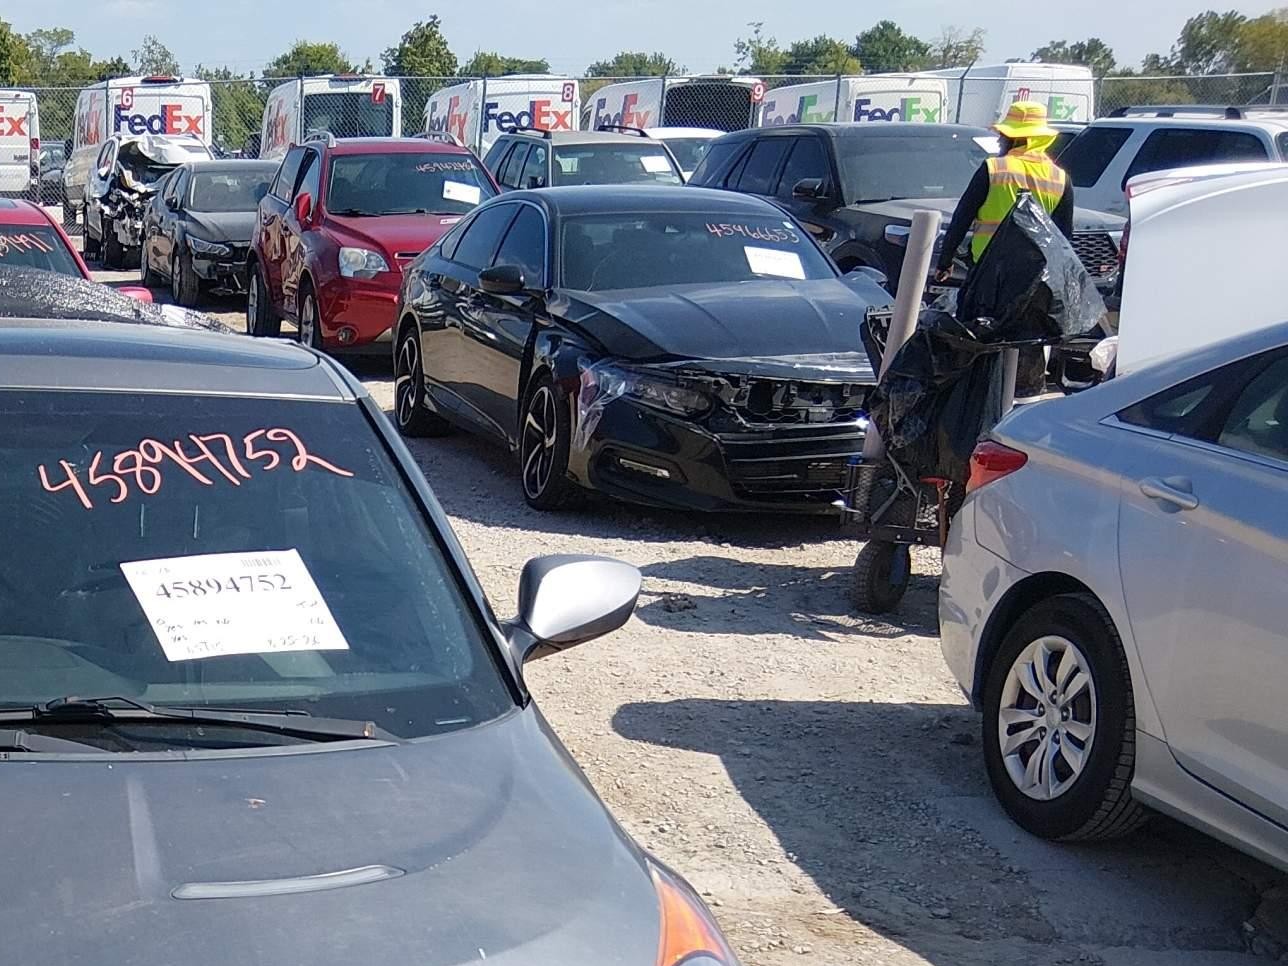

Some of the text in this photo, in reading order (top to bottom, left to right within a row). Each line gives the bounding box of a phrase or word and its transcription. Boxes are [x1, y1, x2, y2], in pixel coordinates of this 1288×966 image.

[122, 90, 132, 107] 6
[374, 85, 383, 100] 7
[563, 85, 573, 100] 8
[754, 85, 763, 99] 9
[114, 105, 202, 135] FedEx
[484, 100, 571, 133] FedEx
[38, 428, 354, 509] 45894752
[156, 574, 292, 599] 45894752
